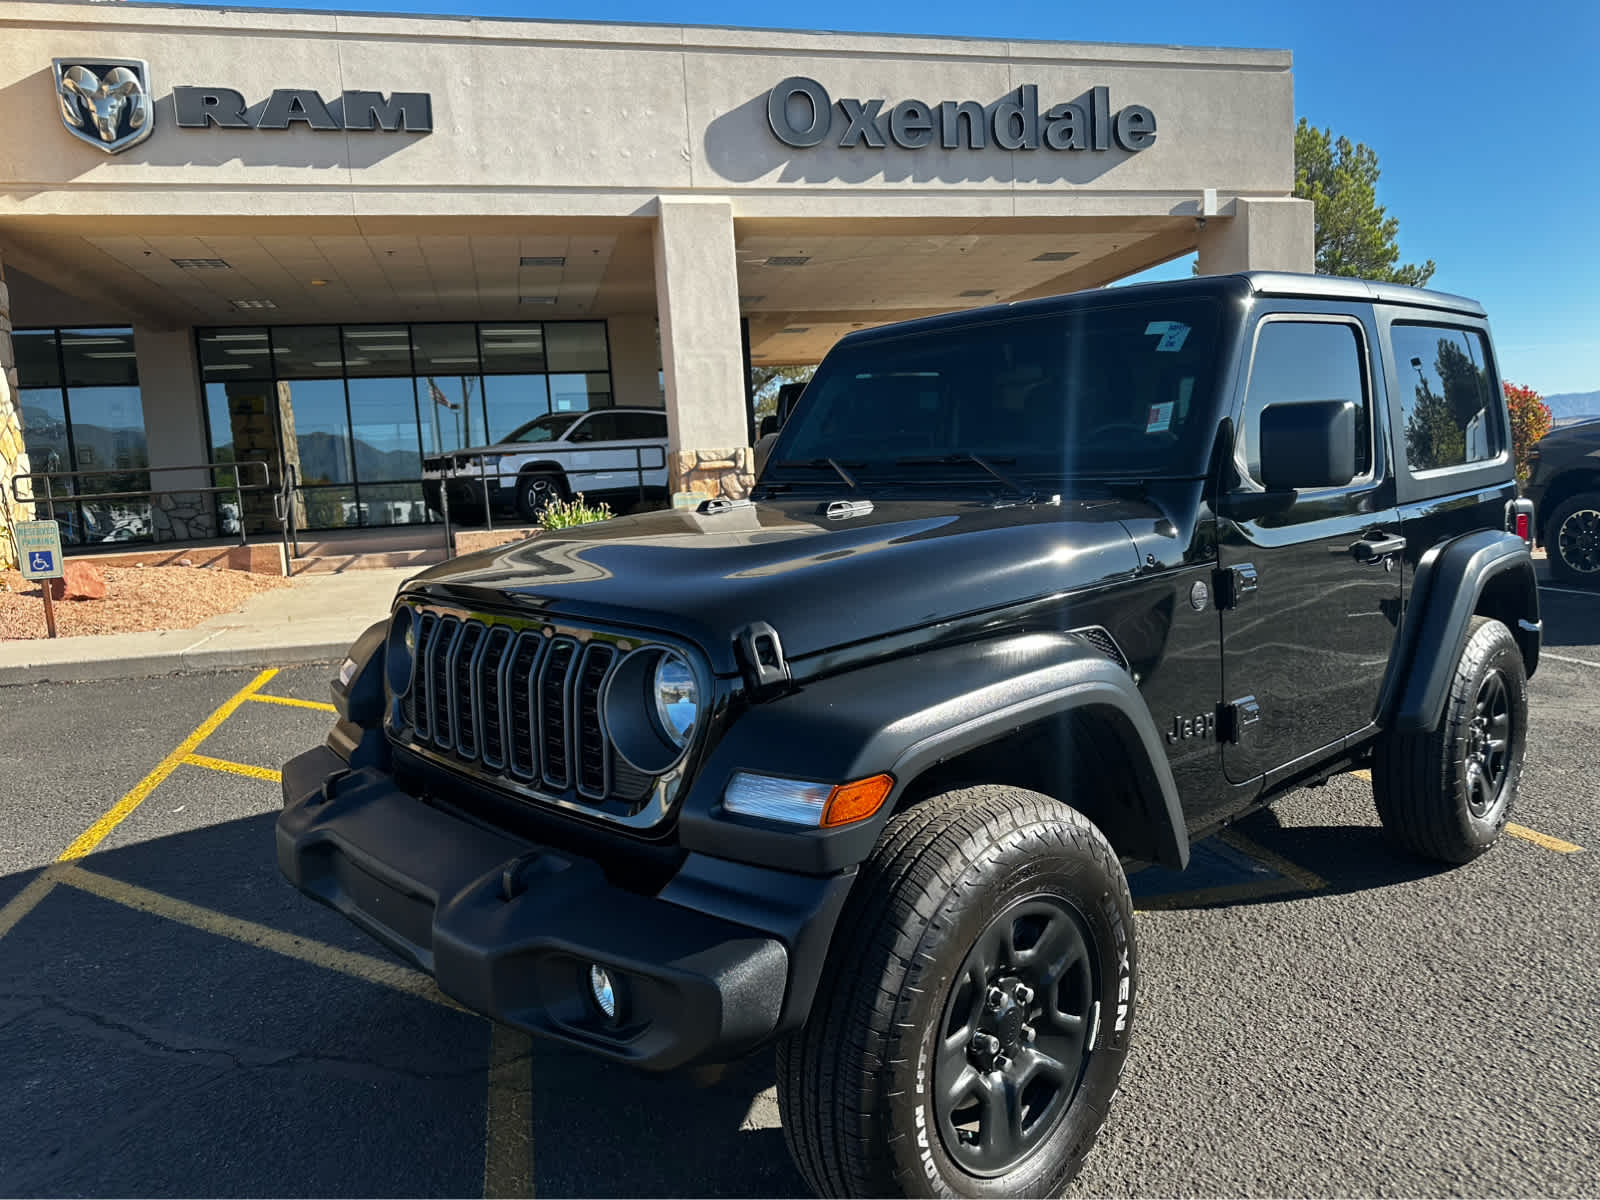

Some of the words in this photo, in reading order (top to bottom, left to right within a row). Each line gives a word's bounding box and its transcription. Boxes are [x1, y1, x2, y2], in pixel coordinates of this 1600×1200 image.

[172, 85, 433, 133] RAM
[768, 76, 1157, 152] Oxendale
[18, 526, 57, 537] RESERVED
[22, 537, 55, 546] PARKING
[1167, 711, 1215, 744] Jeep
